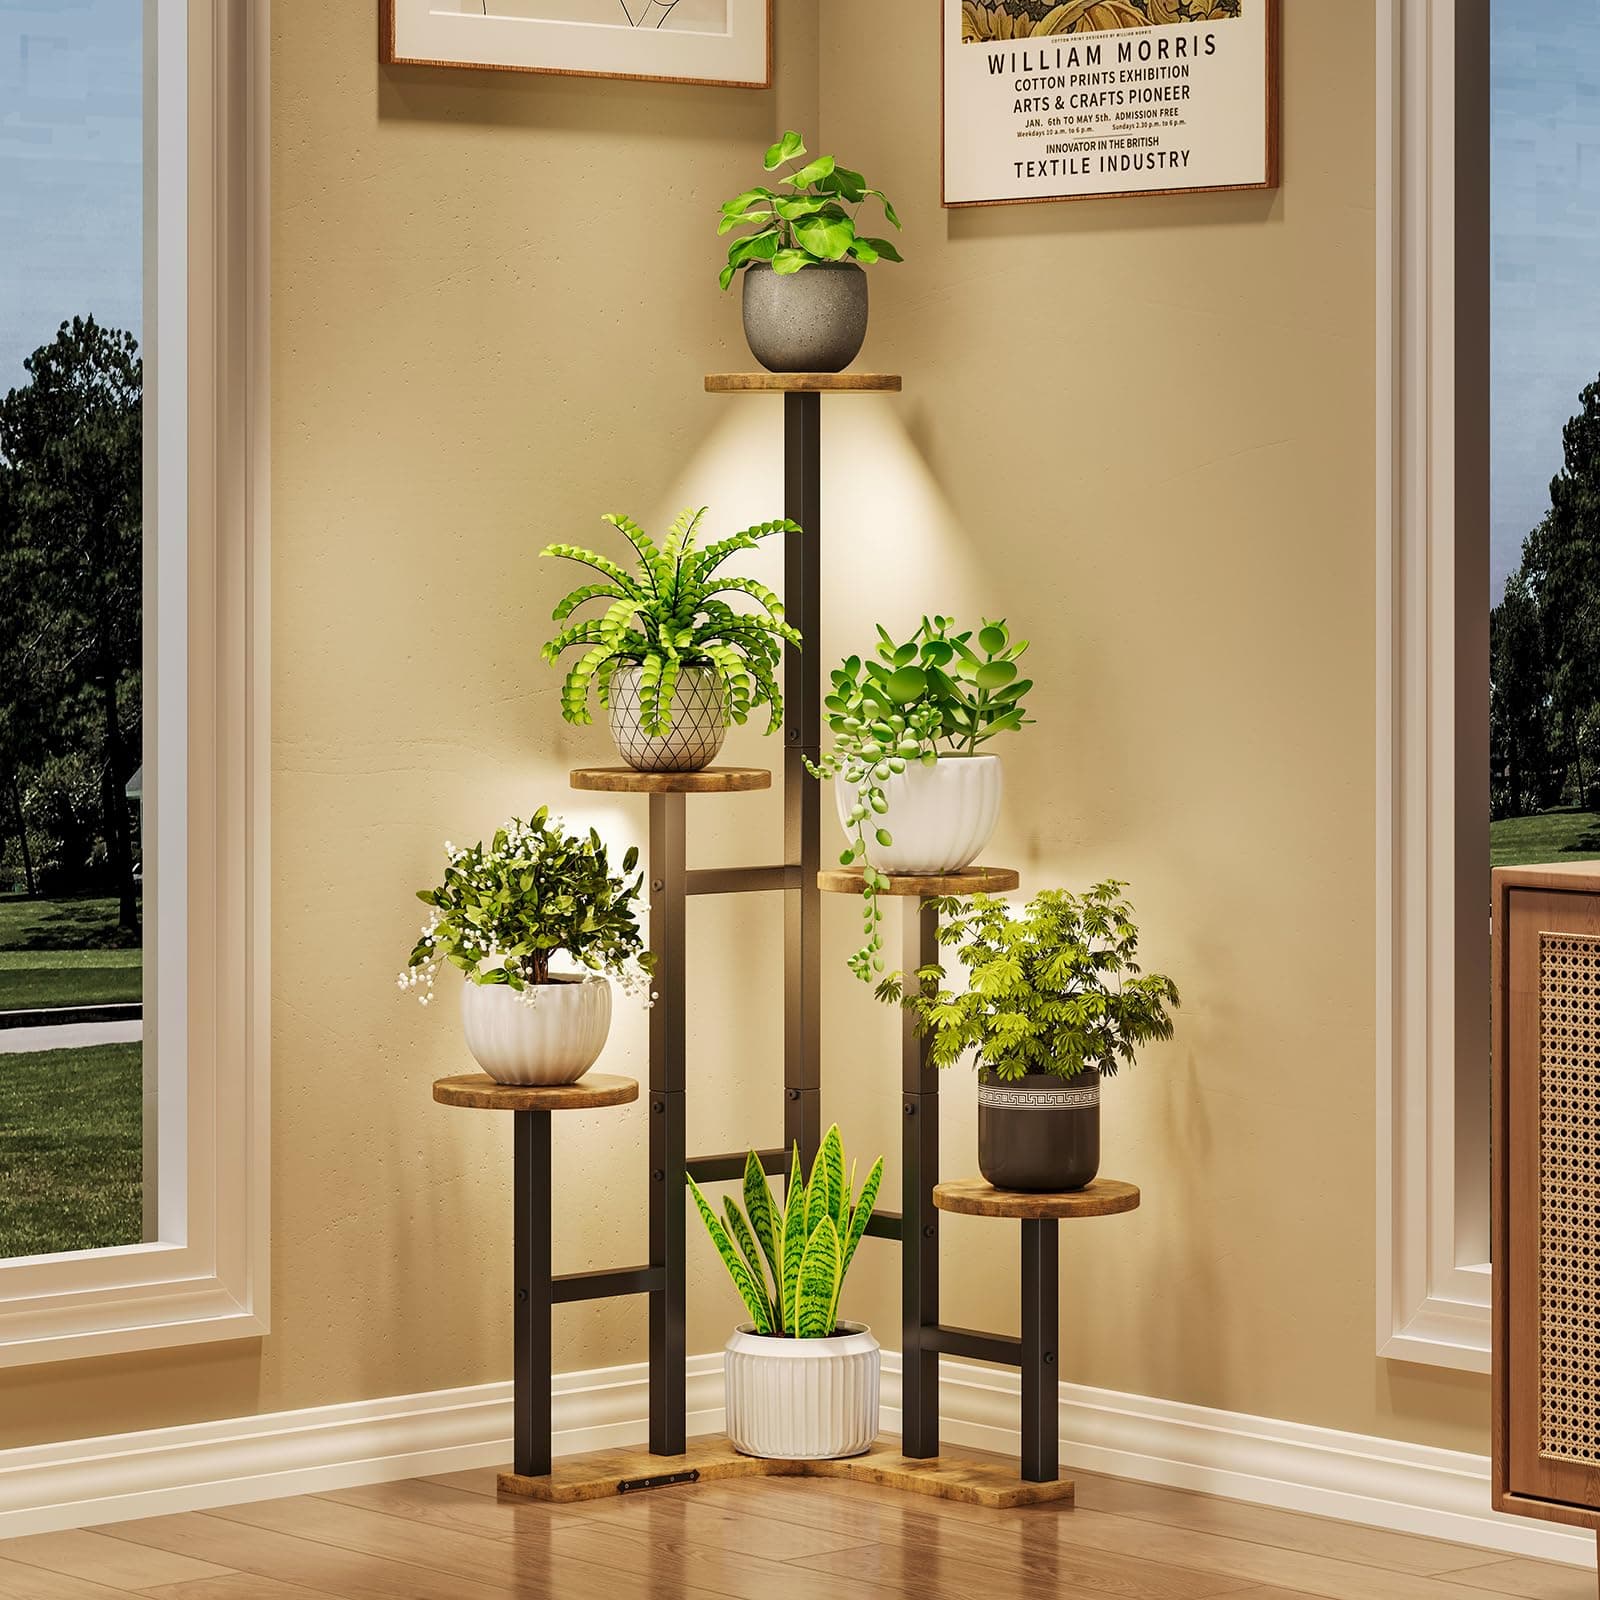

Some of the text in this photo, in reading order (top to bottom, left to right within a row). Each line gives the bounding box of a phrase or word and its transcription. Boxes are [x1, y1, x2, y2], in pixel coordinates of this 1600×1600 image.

[988, 34, 1216, 74] WILLIAM MORRIS
[1014, 64, 1190, 92] COTTON PRINTS EXHIBITION
[1013, 85, 1190, 114] ARTS & CRAFTS PIONEER
[1025, 108, 1179, 128] JAN. 6th TO MAY 5th. ADMISSION FREE
[1046, 136, 1160, 154] INNOVATOR IN THE BRITISH
[1014, 150, 1190, 178] TEXTILE INDUSTRY
